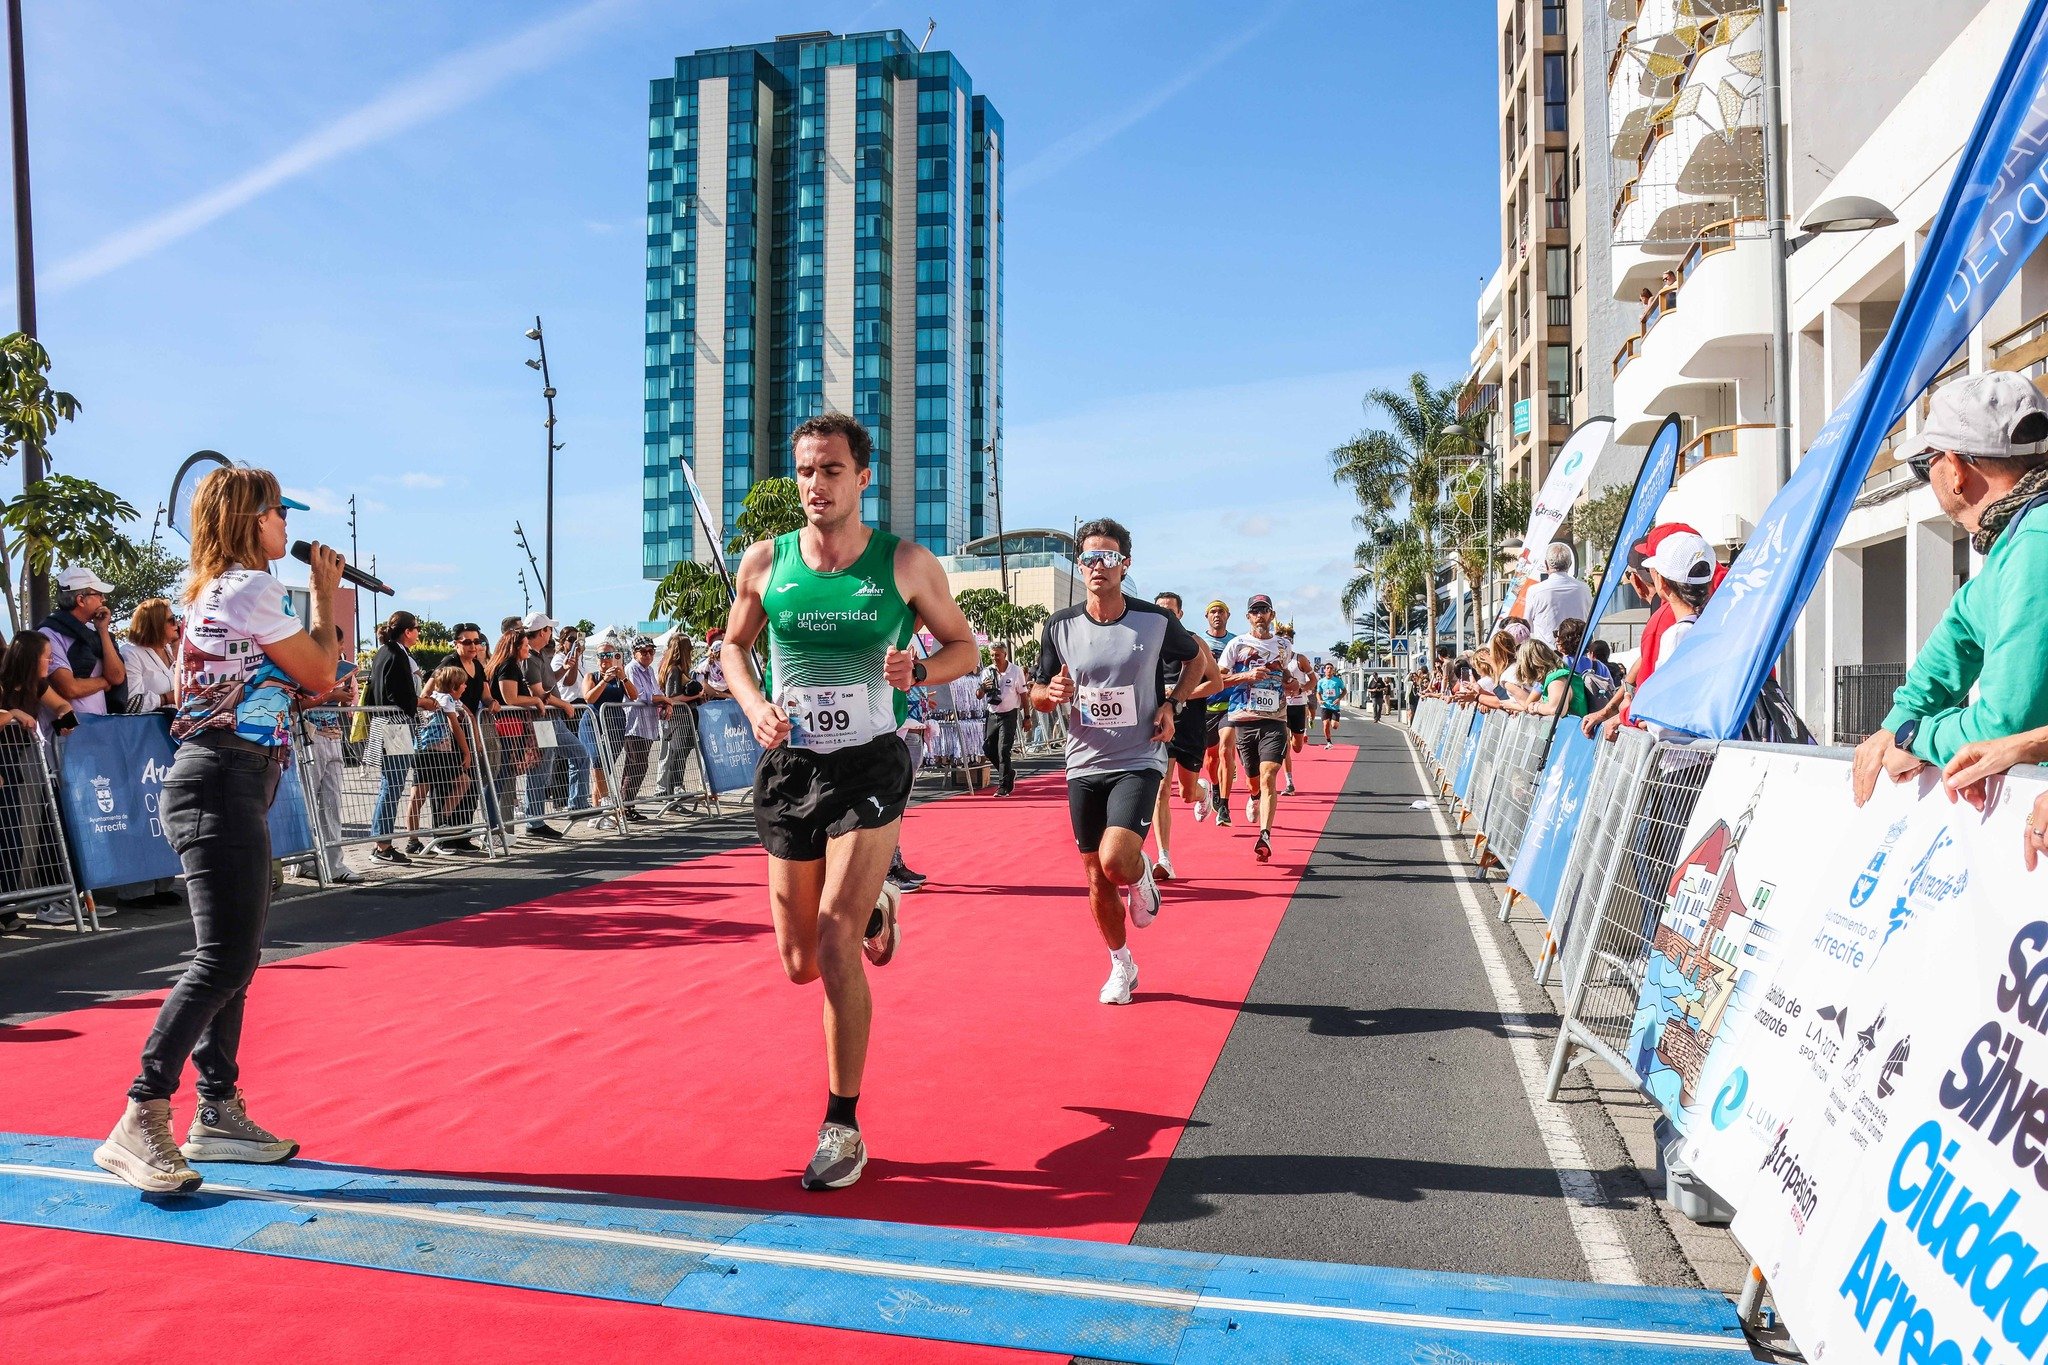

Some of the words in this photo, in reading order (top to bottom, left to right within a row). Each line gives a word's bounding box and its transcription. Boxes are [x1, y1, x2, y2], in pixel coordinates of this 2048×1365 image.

[1946, 157, 2048, 313] DEPO
[797, 610, 877, 621] universidad
[797, 620, 808, 628] de
[808, 619, 837, 631] león
[1256, 696, 1273, 706] 800
[1090, 703, 1122, 717] 690
[804, 710, 850, 732] 199
[95, 821, 127, 833] Arrecife
[1811, 926, 1864, 969] Arrecife
[1785, 998, 1801, 1018] de
[1754, 1007, 1788, 1037] anzarote
